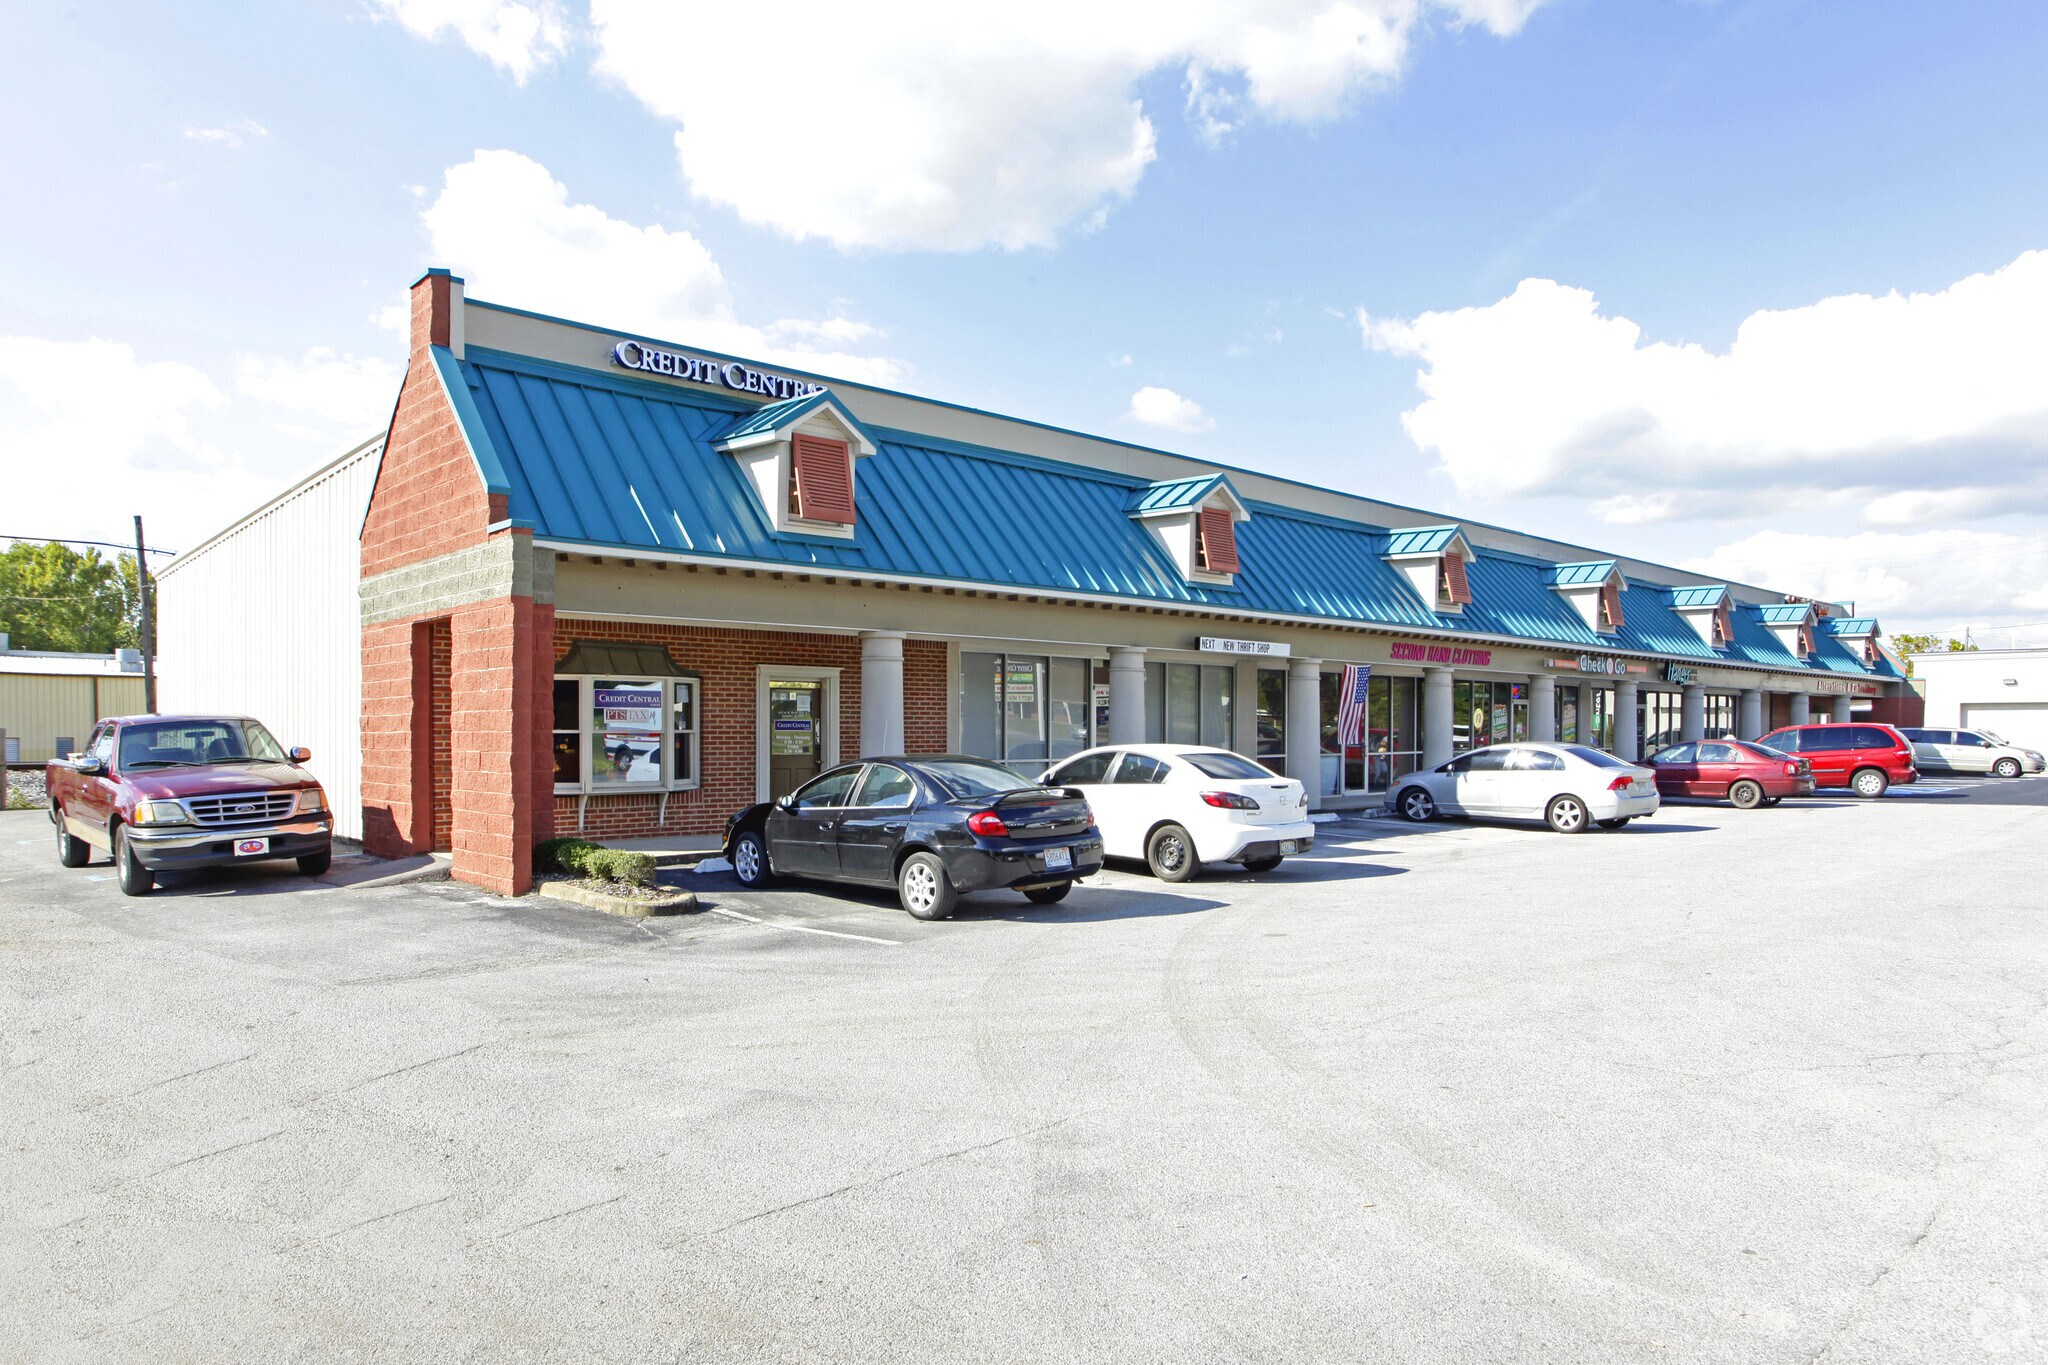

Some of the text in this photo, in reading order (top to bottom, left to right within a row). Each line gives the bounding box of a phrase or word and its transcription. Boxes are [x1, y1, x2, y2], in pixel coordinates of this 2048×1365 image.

[614, 340, 829, 399] CREDIT CENTRA
[1201, 638, 1270, 654] NEXT NEW THRIFT SHOP
[1390, 642, 1492, 666] SECOND HAND CLOTHING
[1580, 654, 1607, 674] Check
[1614, 658, 1626, 674] Go
[1667, 662, 1691, 686] Hanger
[599, 693, 661, 703] CREDIT CENTRAL
[607, 709, 648, 720] PTS TAX
